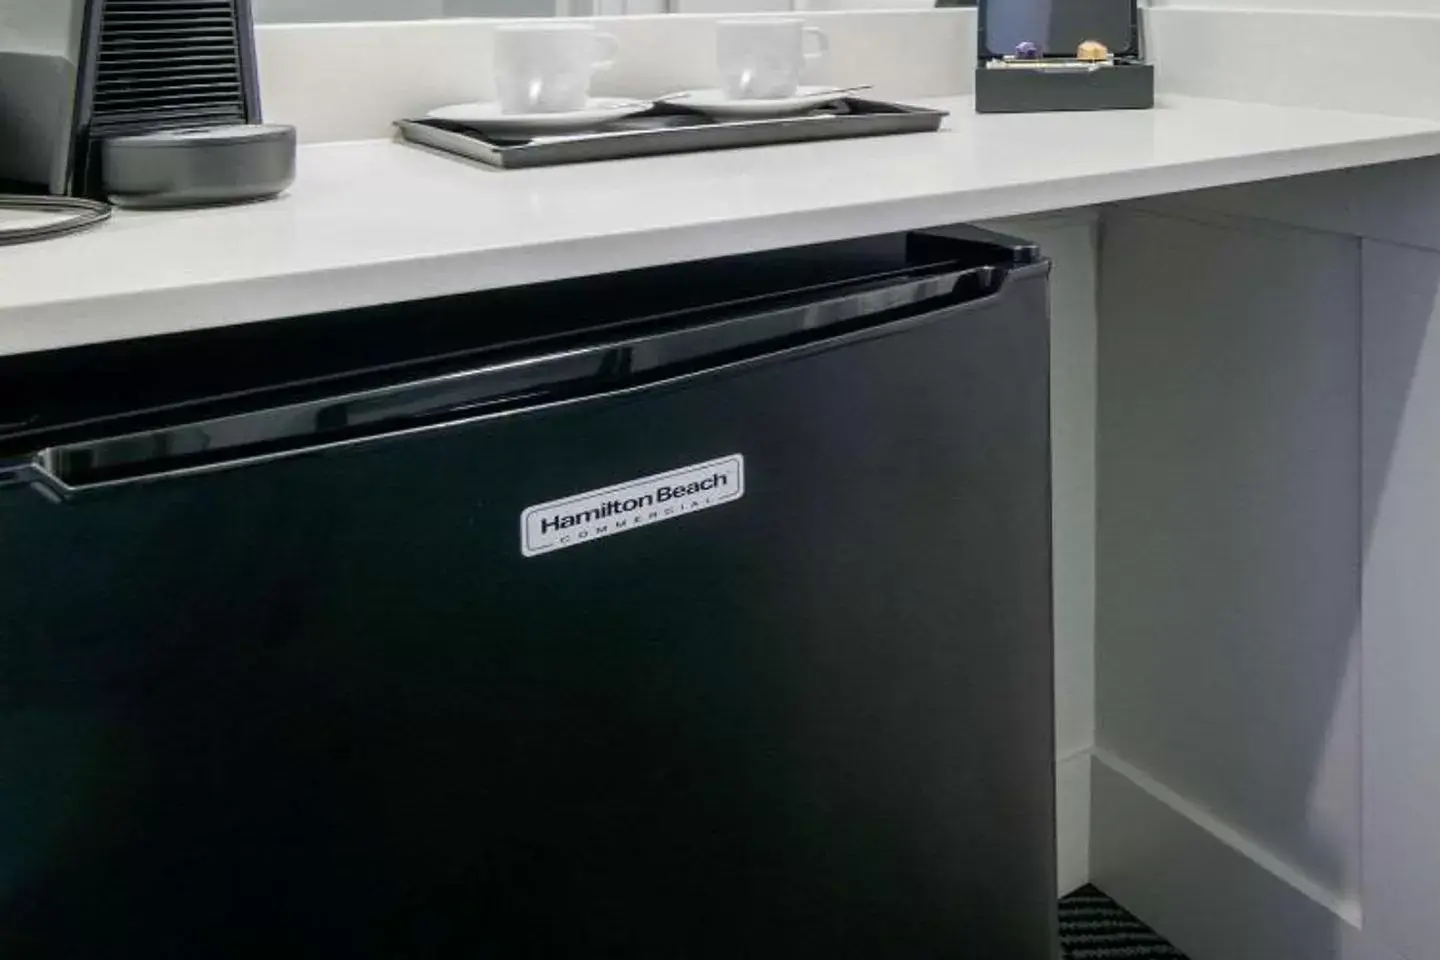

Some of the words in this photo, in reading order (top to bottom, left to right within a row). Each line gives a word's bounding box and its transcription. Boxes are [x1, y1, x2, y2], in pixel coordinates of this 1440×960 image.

[541, 494, 653, 534] Hamilton
[656, 473, 728, 503] Beach
[560, 497, 711, 543] COMMERCIAL
